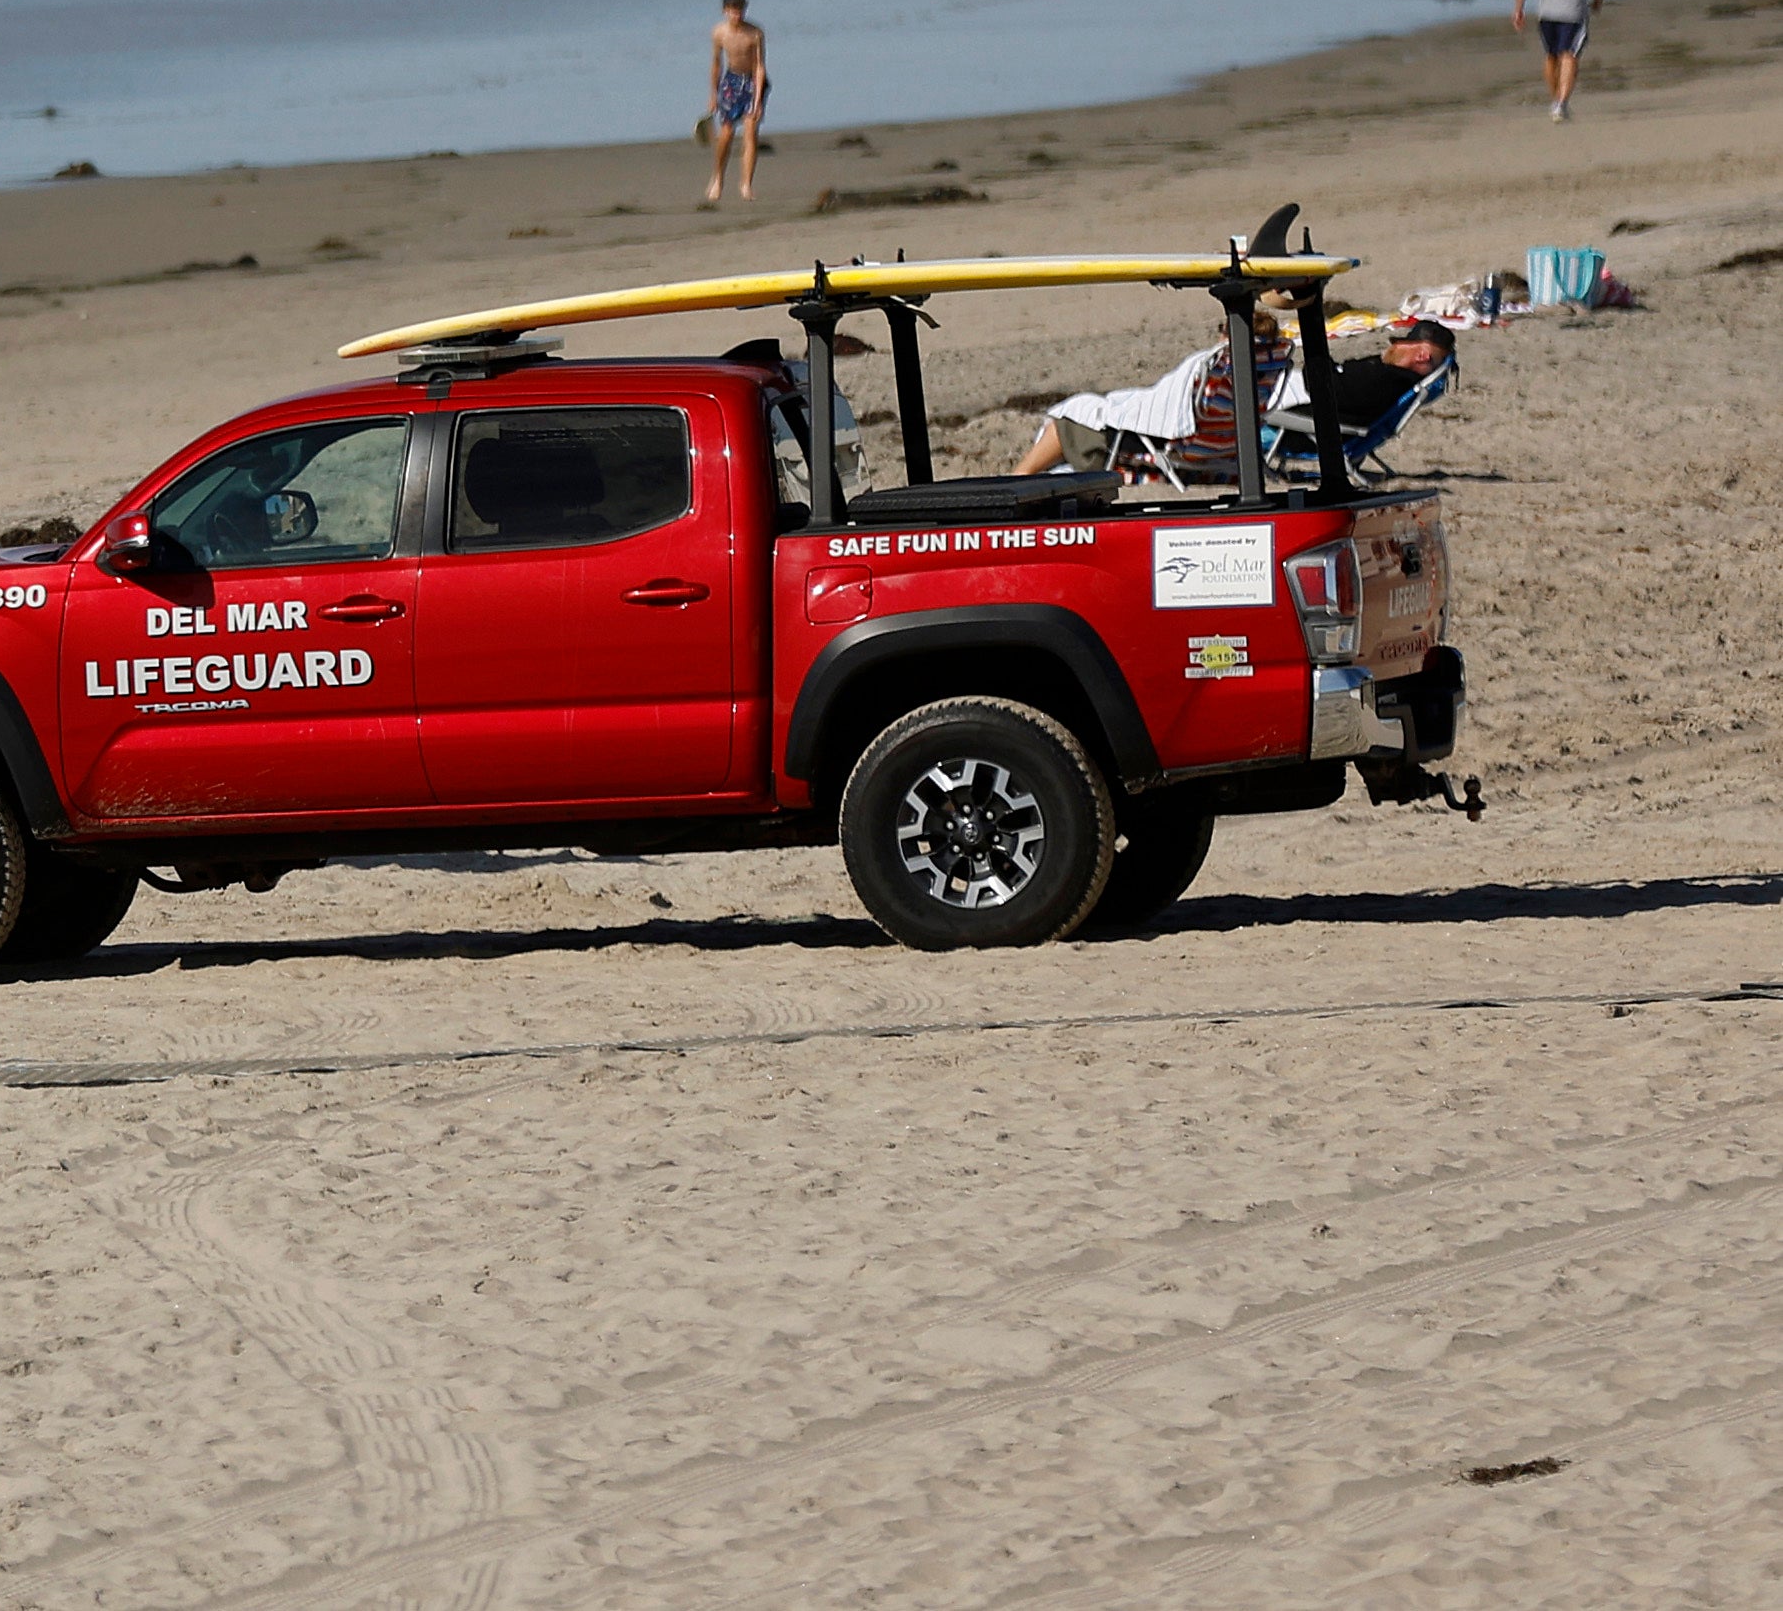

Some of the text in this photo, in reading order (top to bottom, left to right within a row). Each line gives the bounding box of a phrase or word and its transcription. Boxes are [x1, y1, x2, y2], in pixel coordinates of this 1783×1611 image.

[828, 526, 1095, 557] SAFE FUN IN THE SUN
[1202, 553, 1266, 574] Del Mar
[1202, 573, 1266, 584] FOUNDATION
[147, 601, 309, 637] DEL MAR
[85, 649, 374, 698] LIFEGUARD
[134, 699, 250, 714] TACOMA
